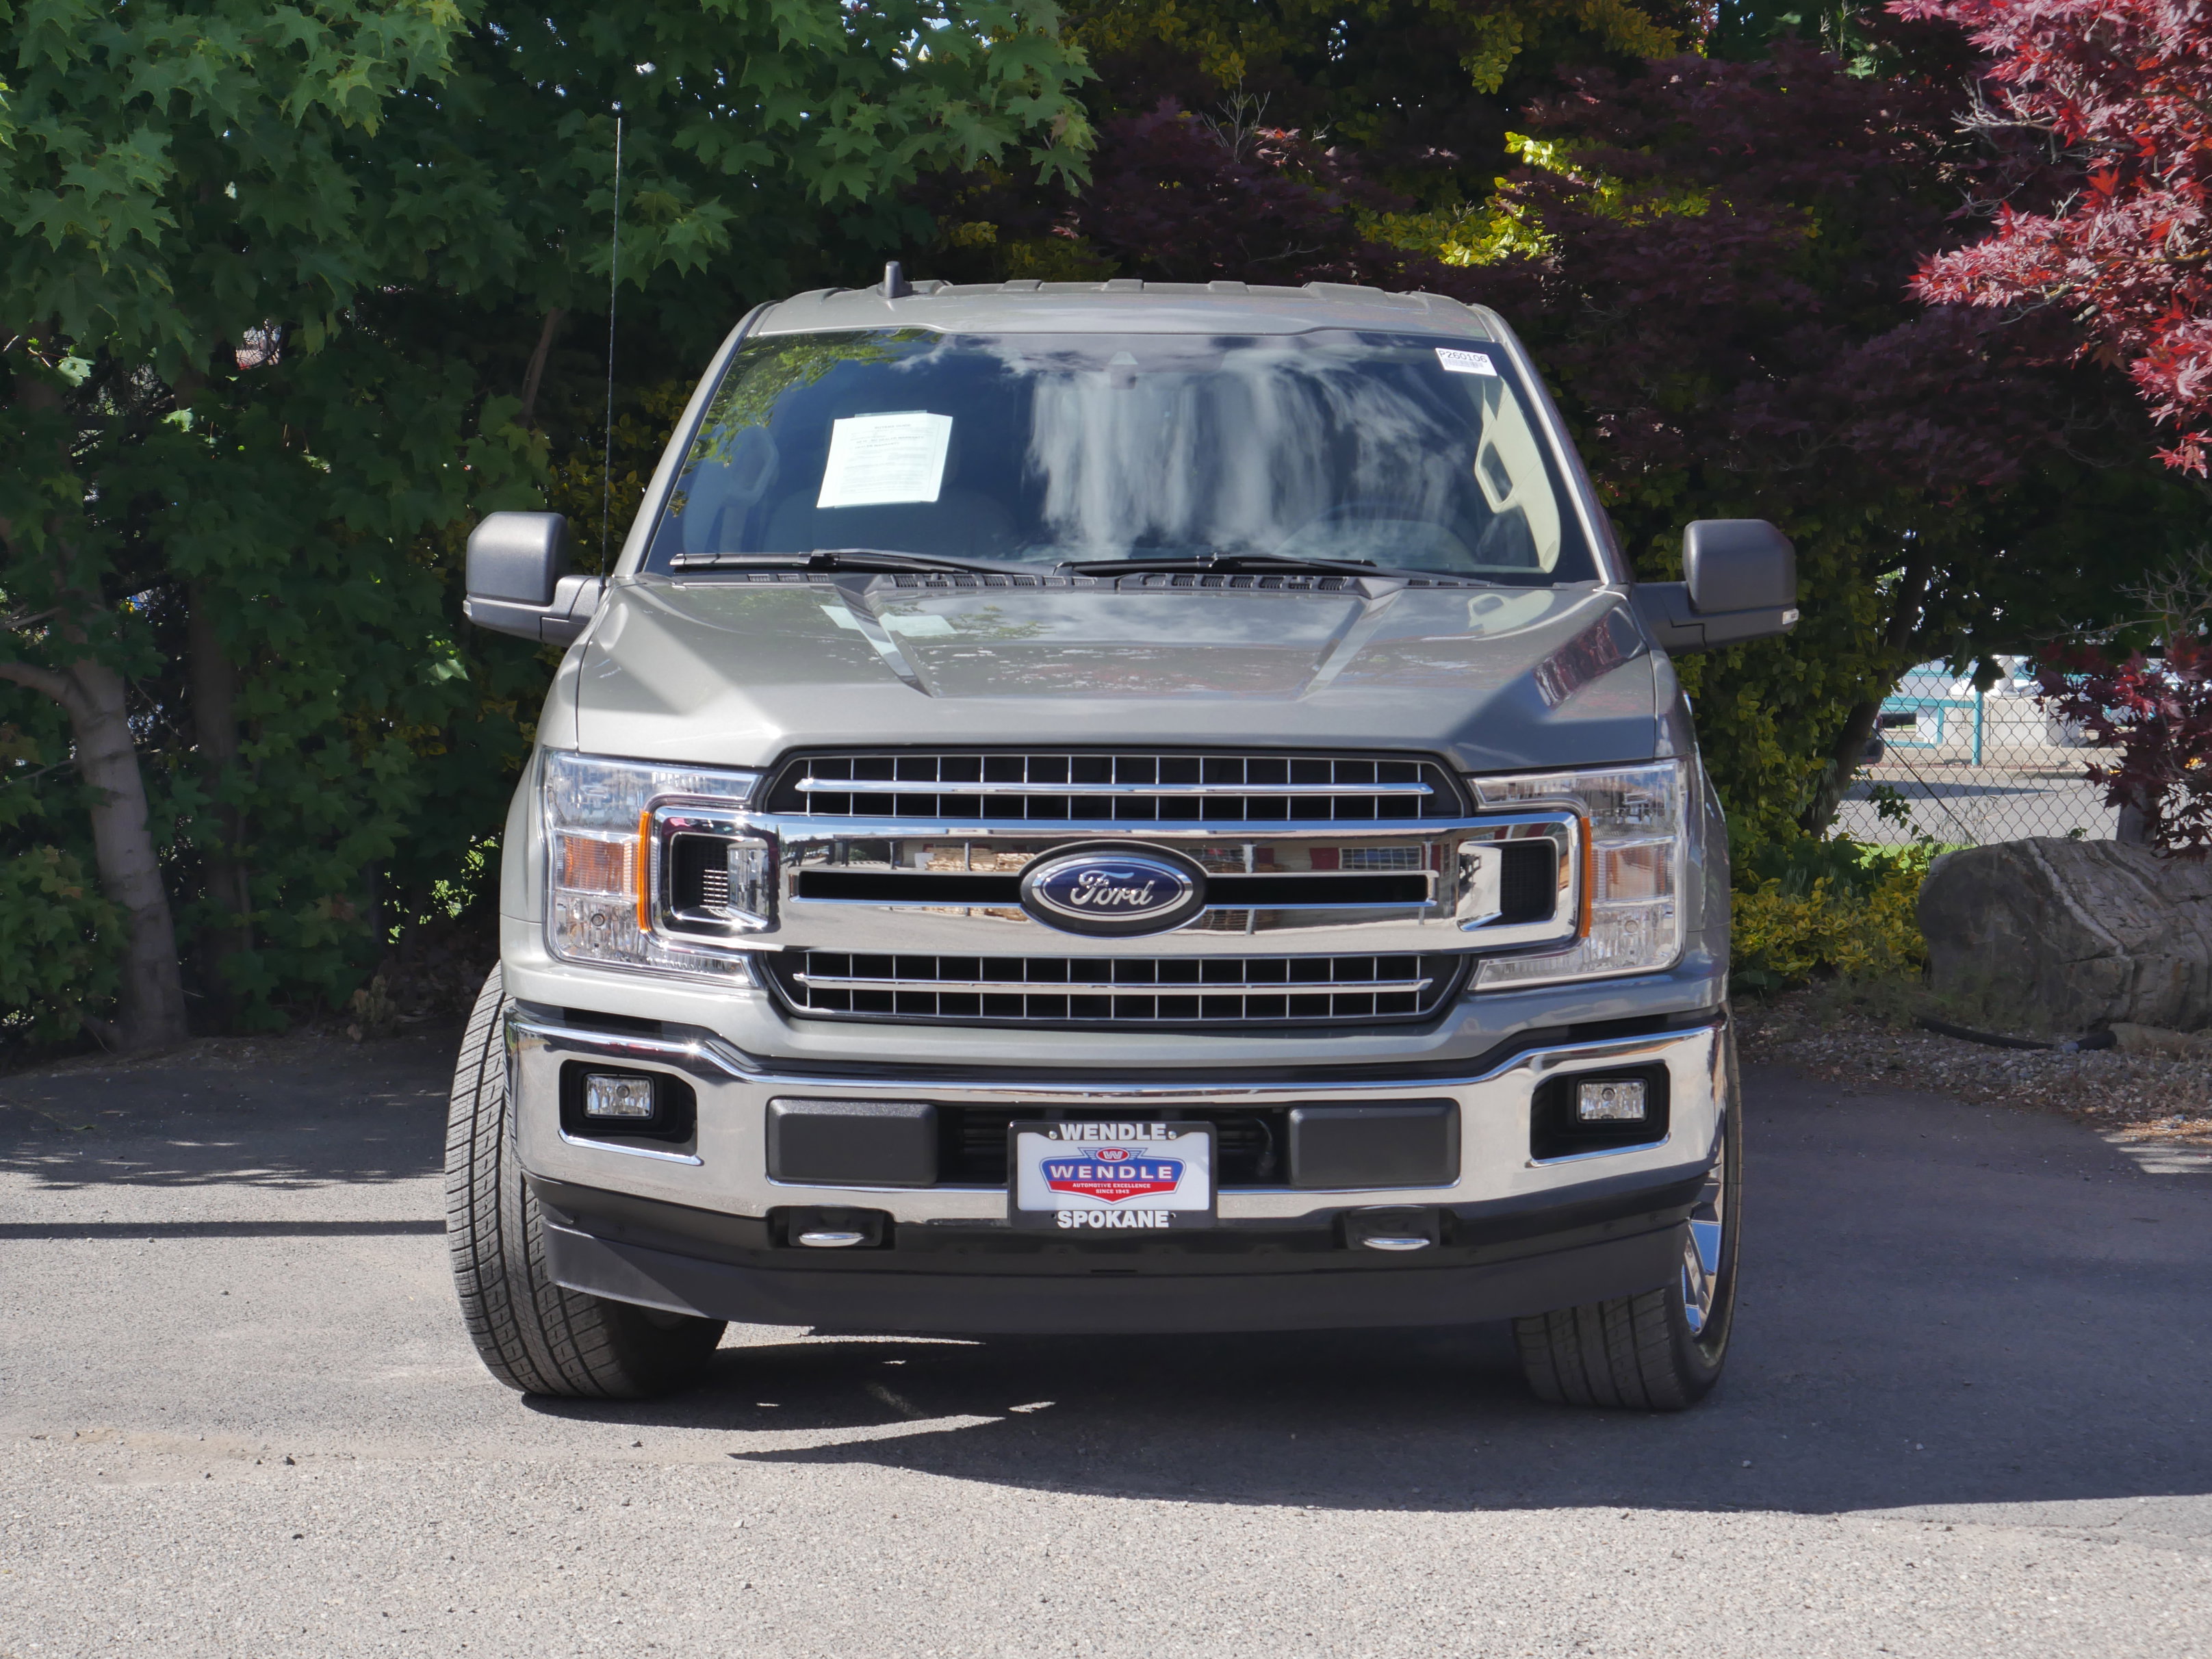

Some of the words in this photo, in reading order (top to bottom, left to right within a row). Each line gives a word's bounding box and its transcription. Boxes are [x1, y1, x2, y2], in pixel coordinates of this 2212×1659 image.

[1438, 350, 1488, 363] P260106
[1070, 870, 1155, 905] Ford
[1059, 1123, 1167, 1140] WENDLE
[1049, 1165, 1172, 1179] WENDLE
[1057, 1210, 1170, 1229] SPOKANE
